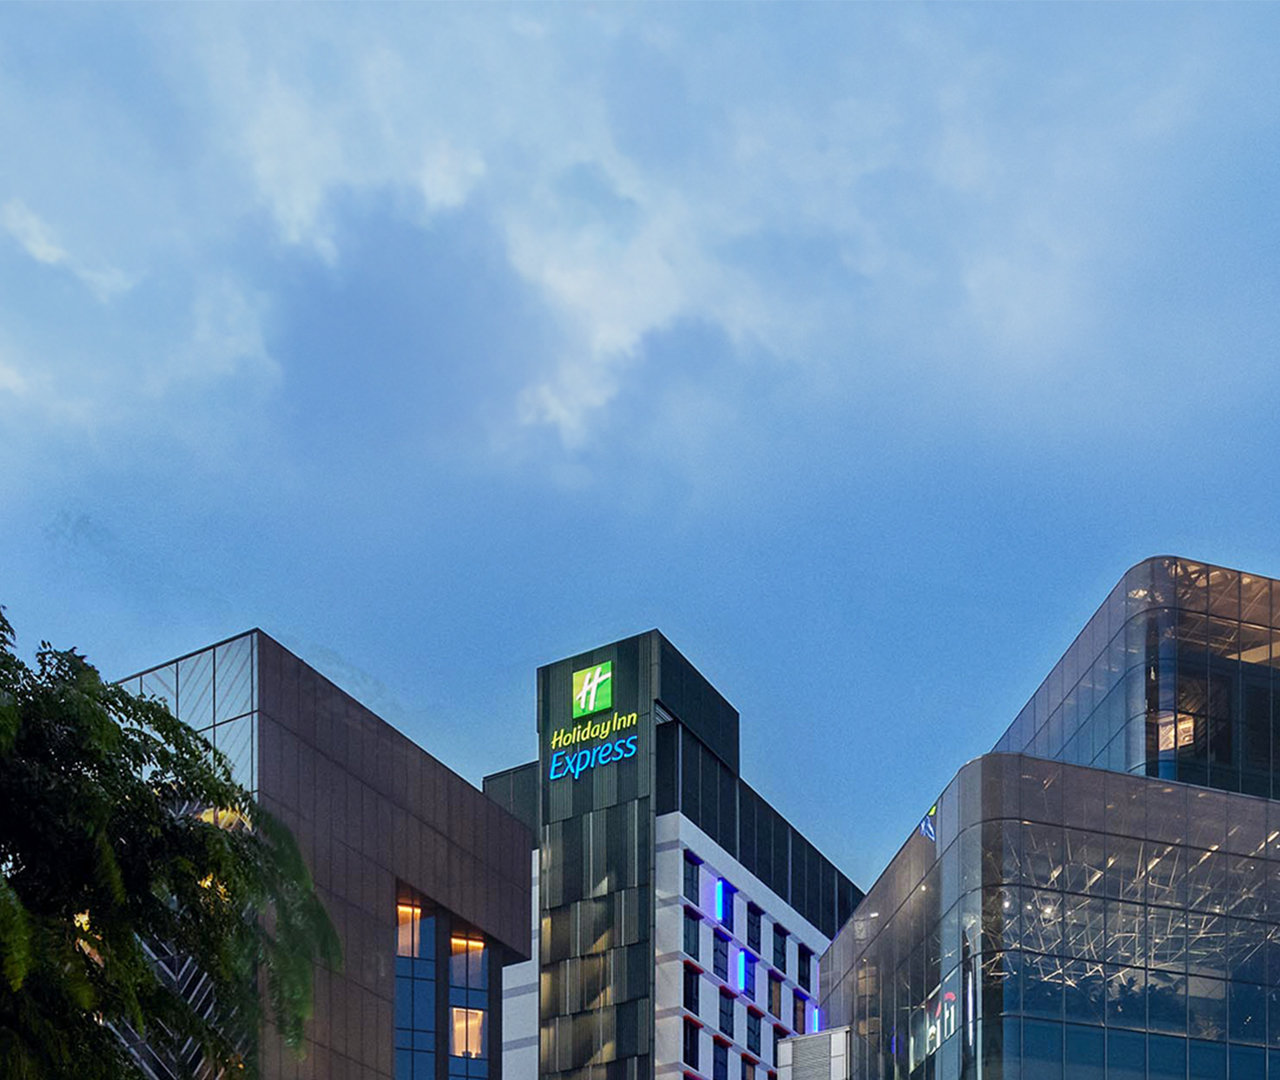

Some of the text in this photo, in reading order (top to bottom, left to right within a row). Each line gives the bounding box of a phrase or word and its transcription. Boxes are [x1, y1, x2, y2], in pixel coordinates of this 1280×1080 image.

[551, 712, 637, 749] Holiday Inn
[550, 735, 638, 779] Express
